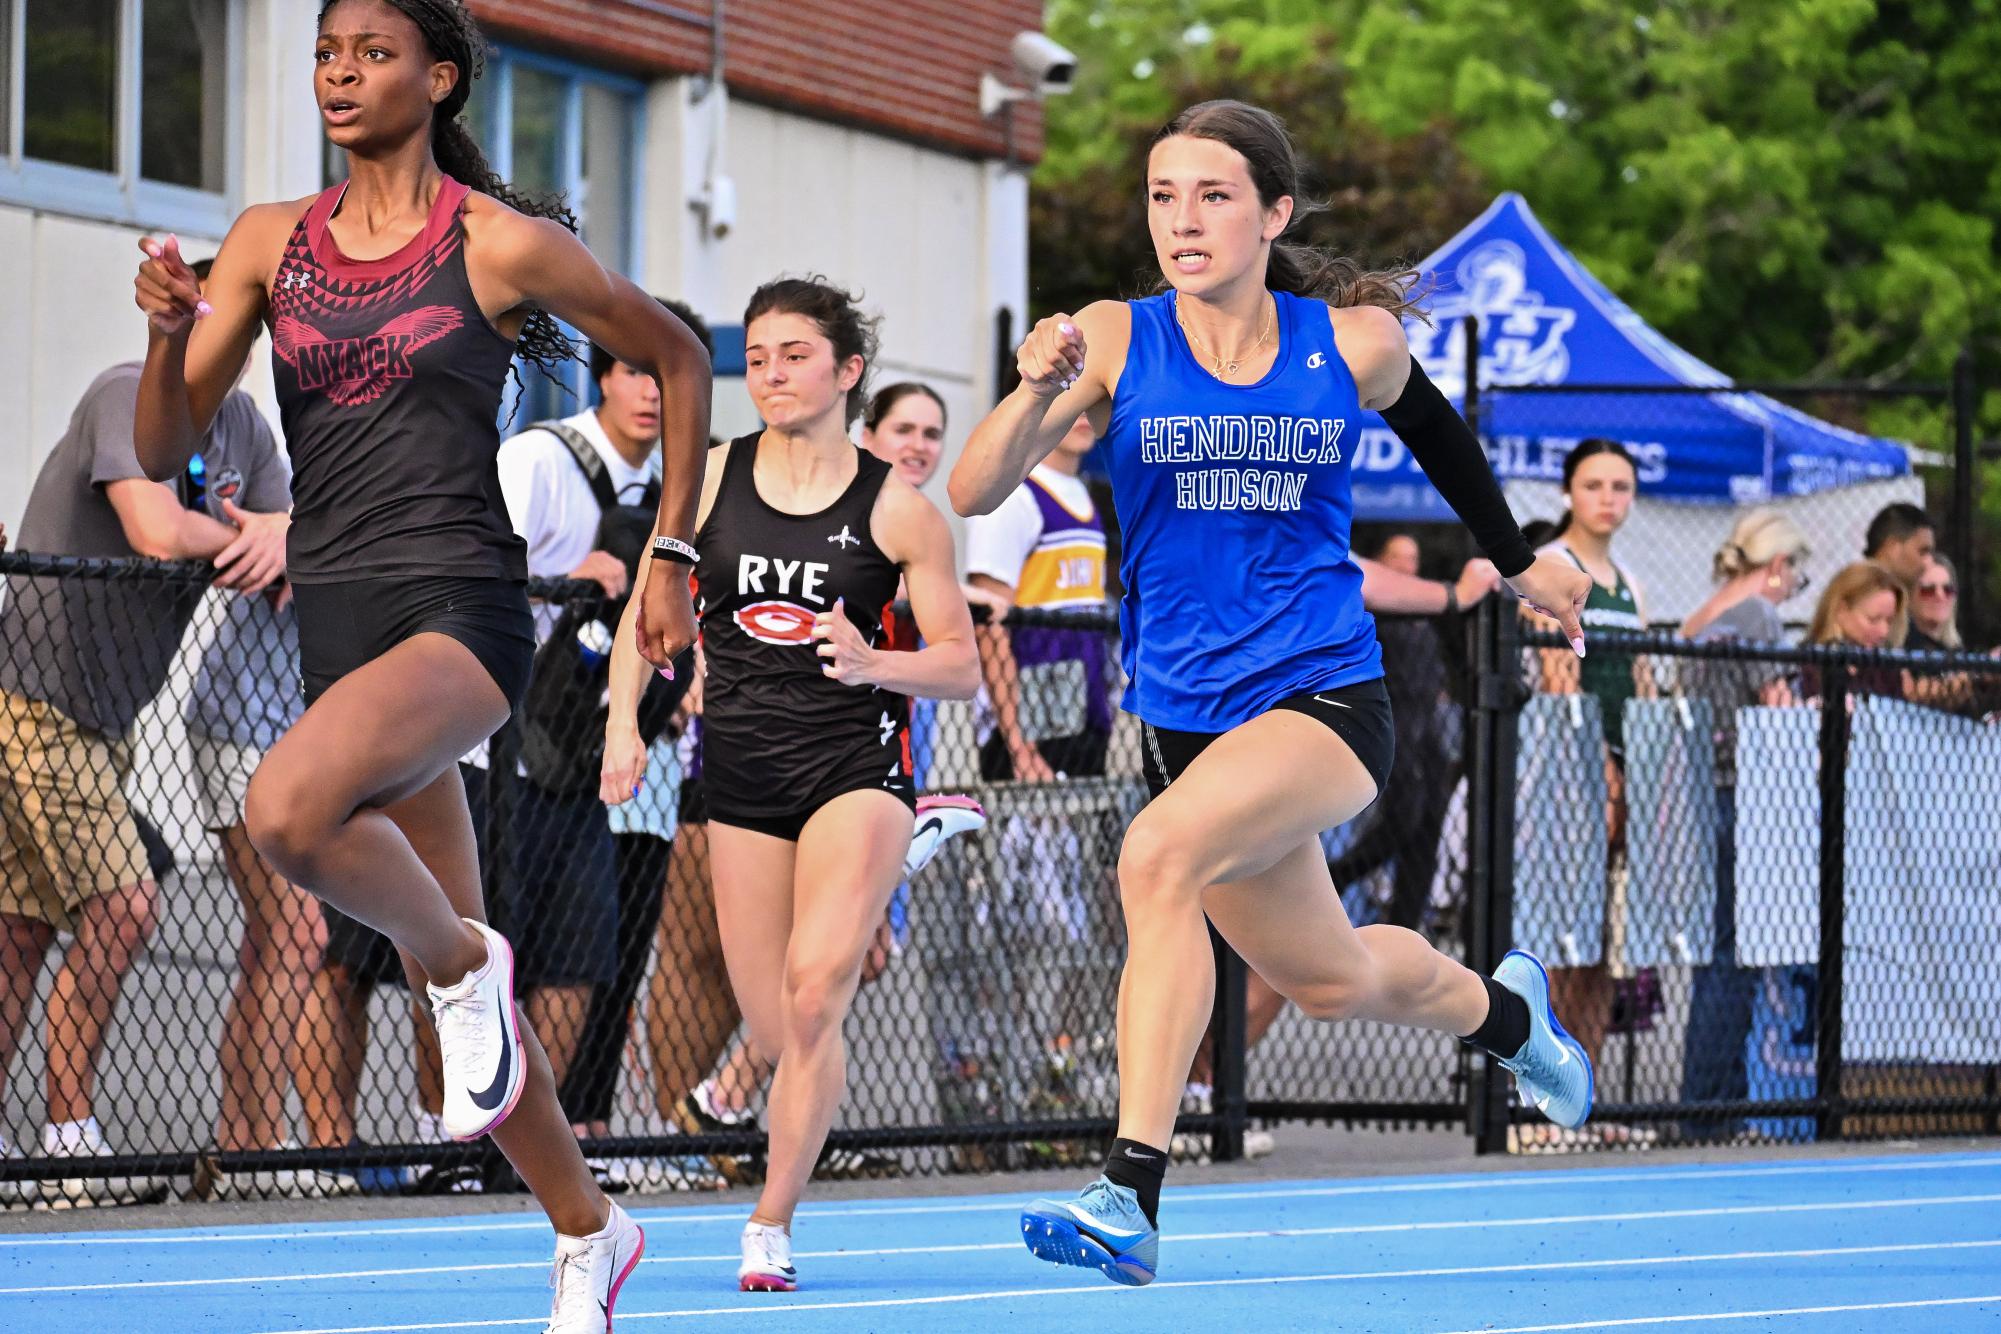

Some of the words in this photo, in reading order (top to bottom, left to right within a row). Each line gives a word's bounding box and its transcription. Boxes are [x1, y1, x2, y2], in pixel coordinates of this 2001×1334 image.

[295, 334, 415, 390] NYACK
[1140, 415, 1345, 464] HENDRICK
[1175, 468, 1308, 511] HUDSON
[738, 553, 830, 605] RYE
